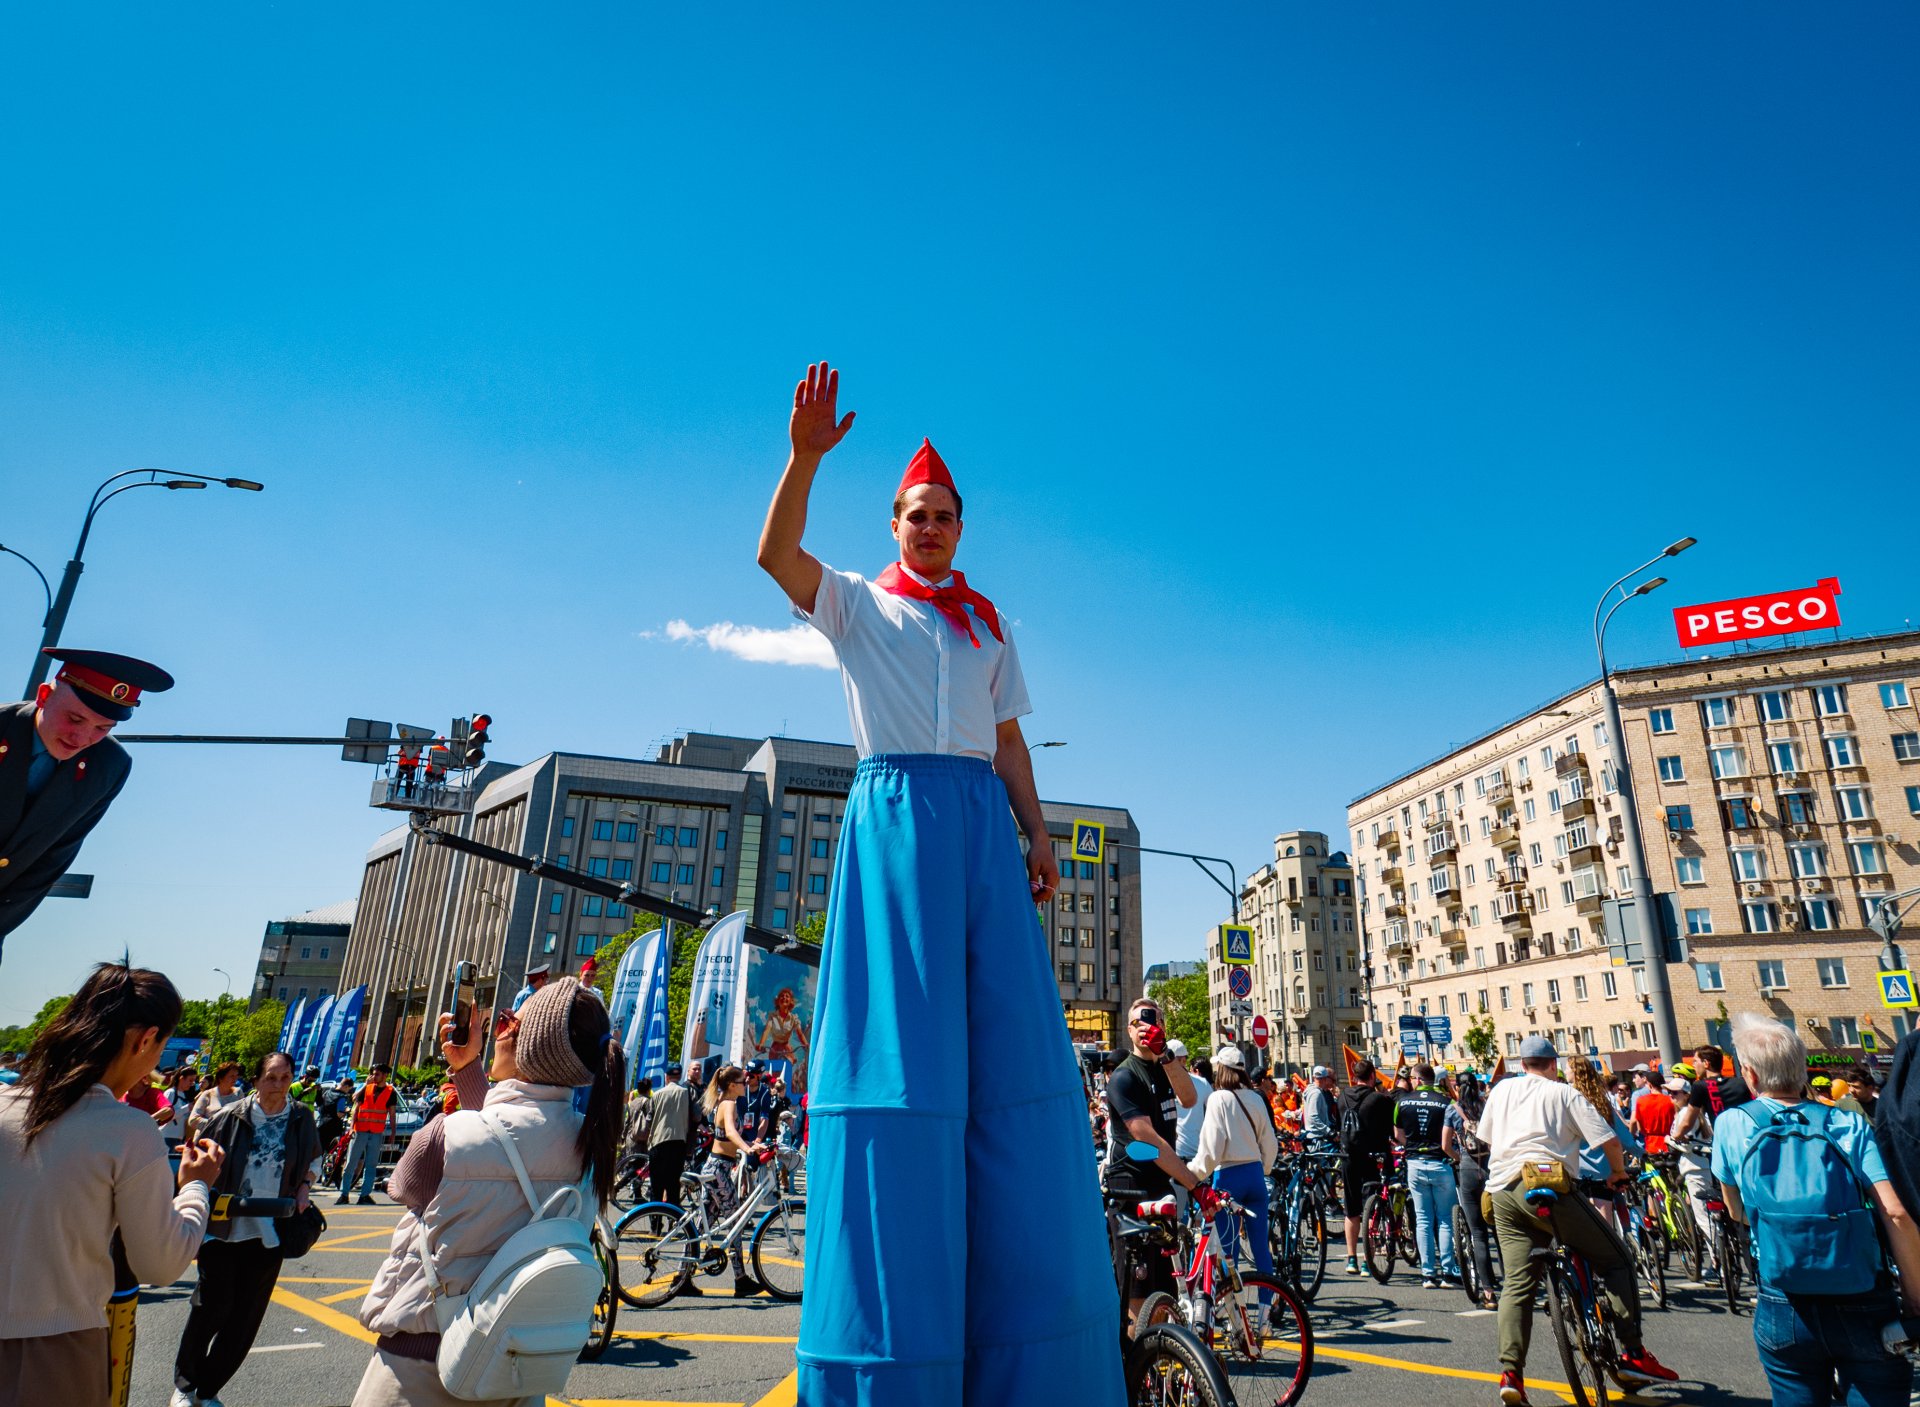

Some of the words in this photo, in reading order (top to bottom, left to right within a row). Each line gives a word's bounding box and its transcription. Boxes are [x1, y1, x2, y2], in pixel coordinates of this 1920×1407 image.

[1687, 597, 1827, 638] PESCO
[704, 955, 733, 964] TECNO
[644, 956, 666, 1088] TECNO
